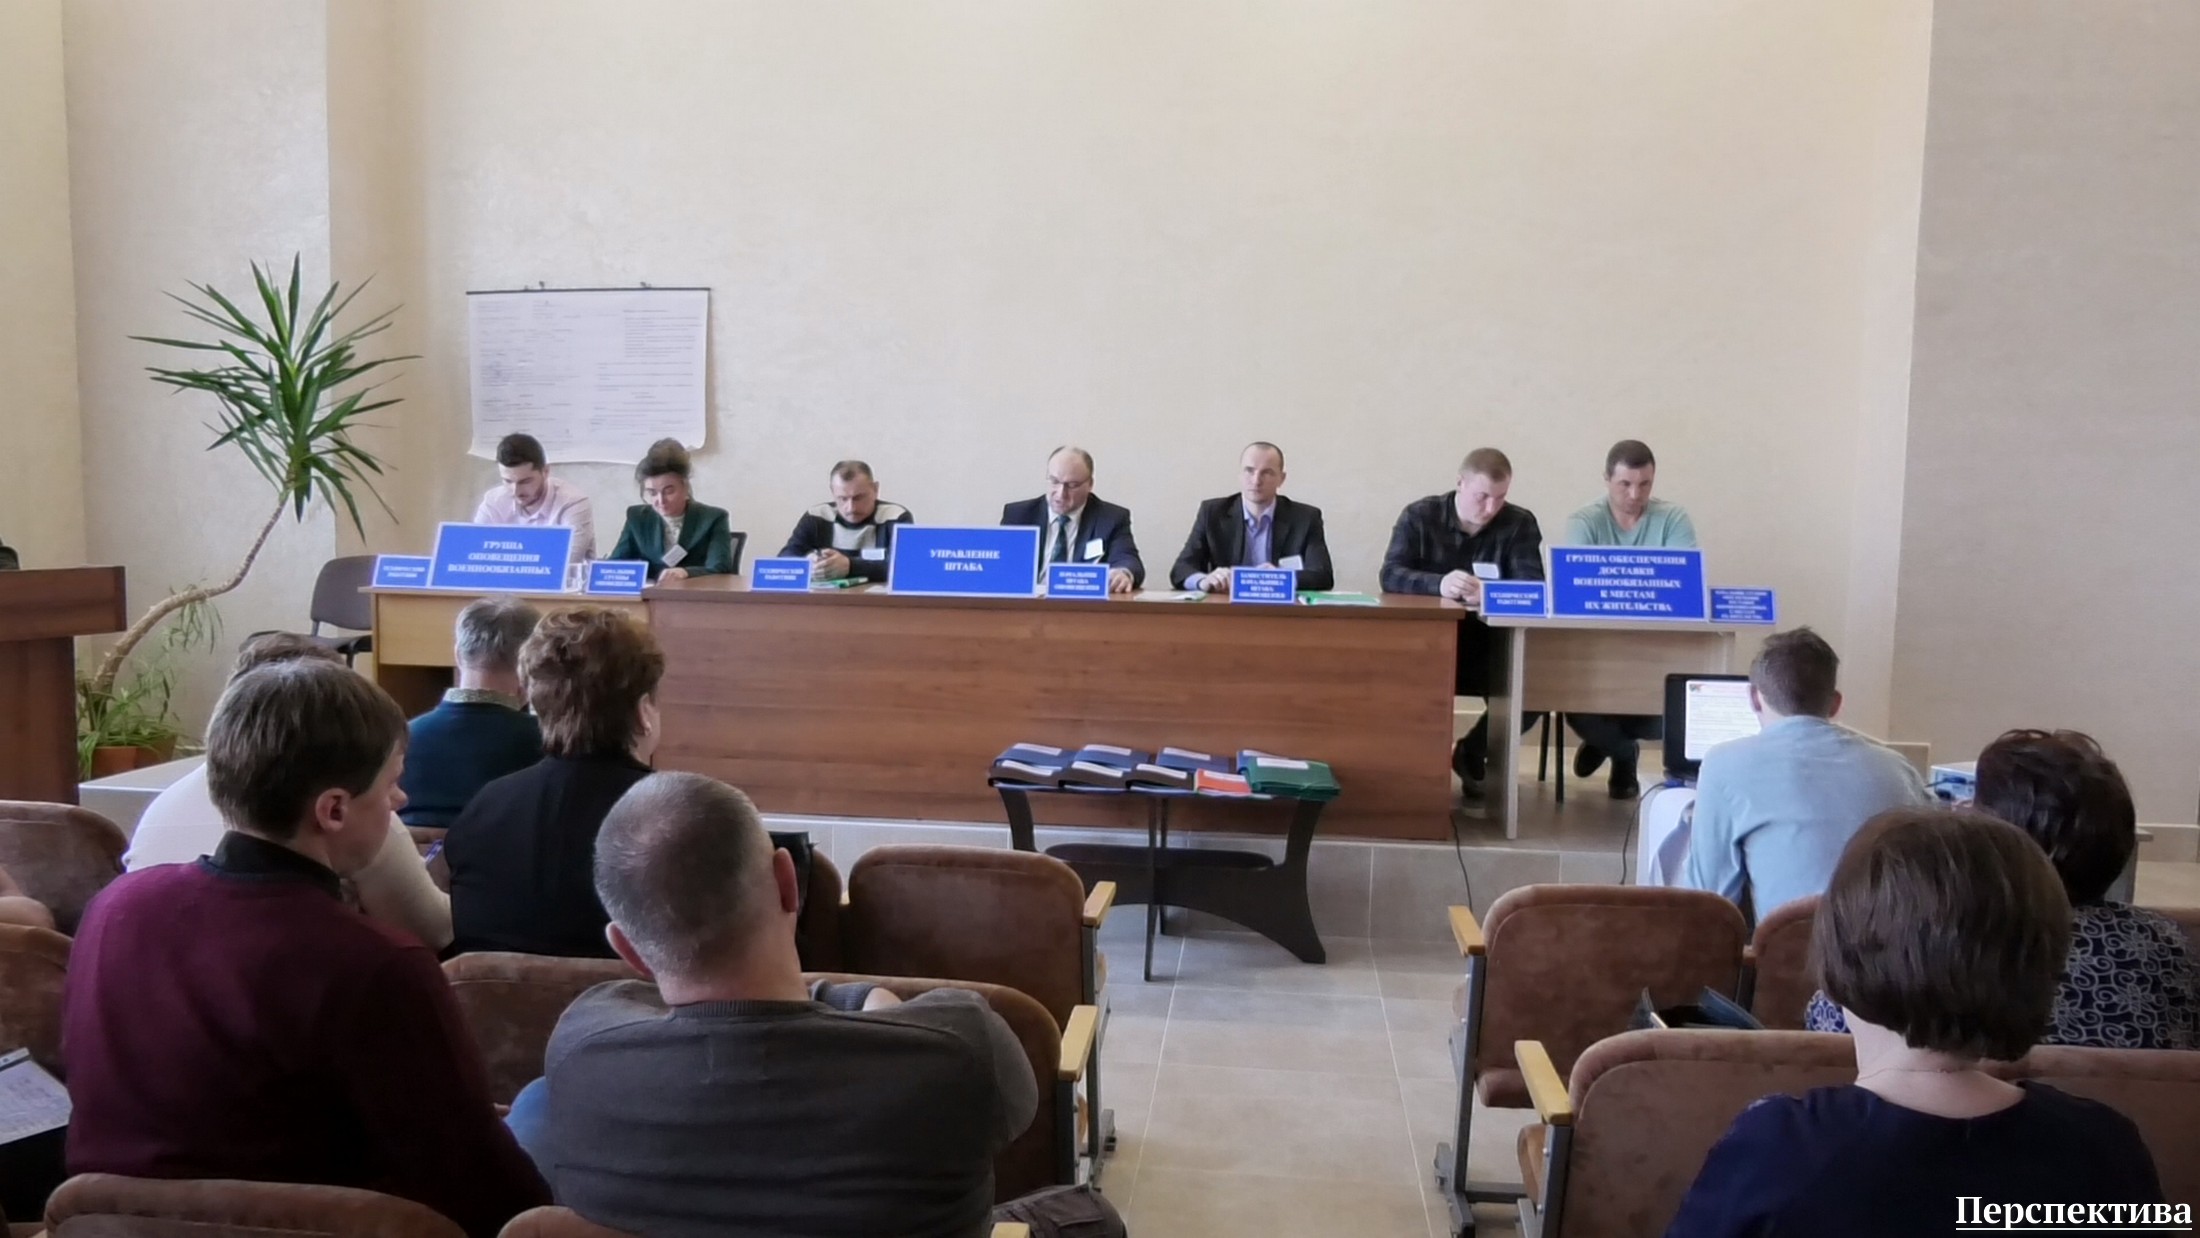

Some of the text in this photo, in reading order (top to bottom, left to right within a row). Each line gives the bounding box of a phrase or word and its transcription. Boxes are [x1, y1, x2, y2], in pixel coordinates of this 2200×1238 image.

[483, 540, 524, 550] ГРУППА
[929, 549, 1000, 559] УПРАВЛЕНИЕ
[1565, 554, 1687, 565] ГРУППА ОБЕСПЕЧЕНИЯ
[944, 562, 984, 571] ШТАБА
[1598, 567, 1656, 576] ДОСТАВКИ
[1573, 577, 1682, 588] ВОЕННООБЯЗАННЫХ
[1600, 589, 1656, 599] К МЕСТАМ
[1584, 601, 1673, 612] ИХ ЖИТЕЛЬСТВА
